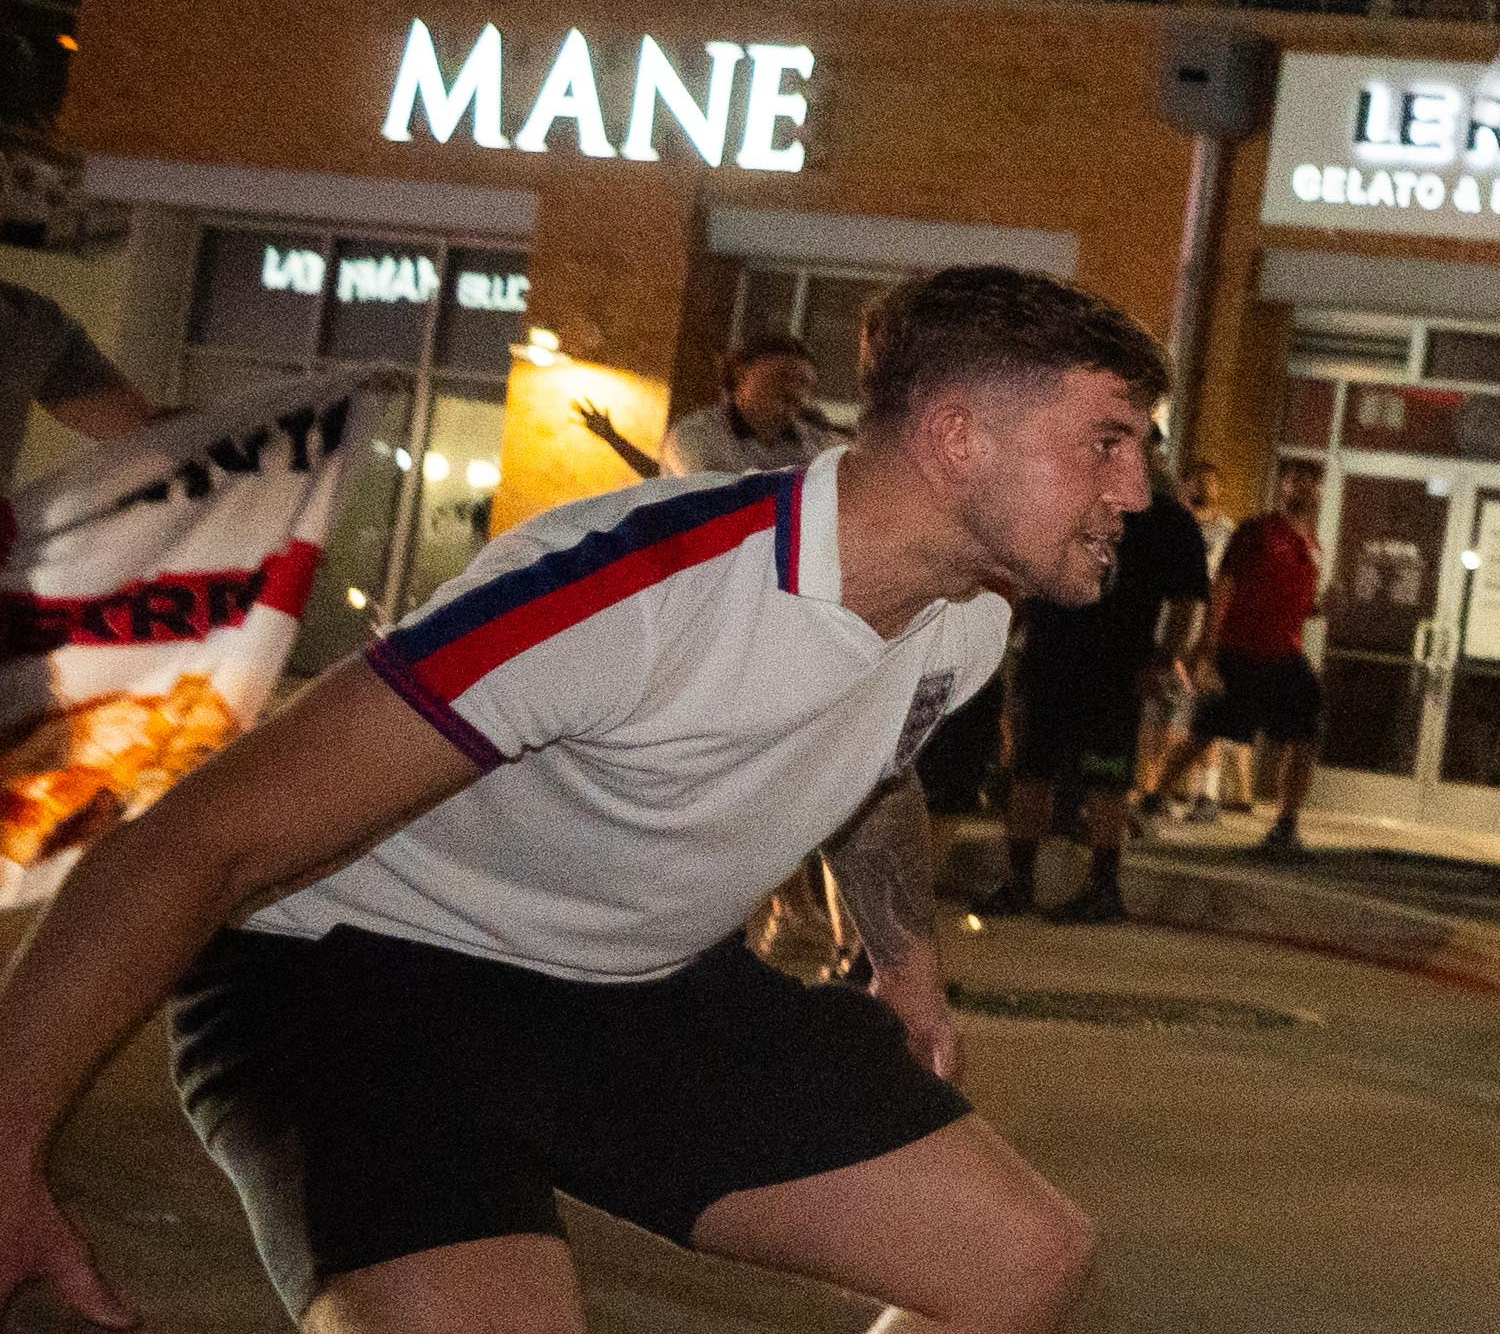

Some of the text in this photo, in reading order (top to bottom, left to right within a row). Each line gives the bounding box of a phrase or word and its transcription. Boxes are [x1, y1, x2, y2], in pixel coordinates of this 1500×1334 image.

[381, 18, 815, 173] MANE
[1354, 83, 1460, 156] LE
[1291, 163, 1447, 212] GELATO
[1453, 174, 1483, 214] &
